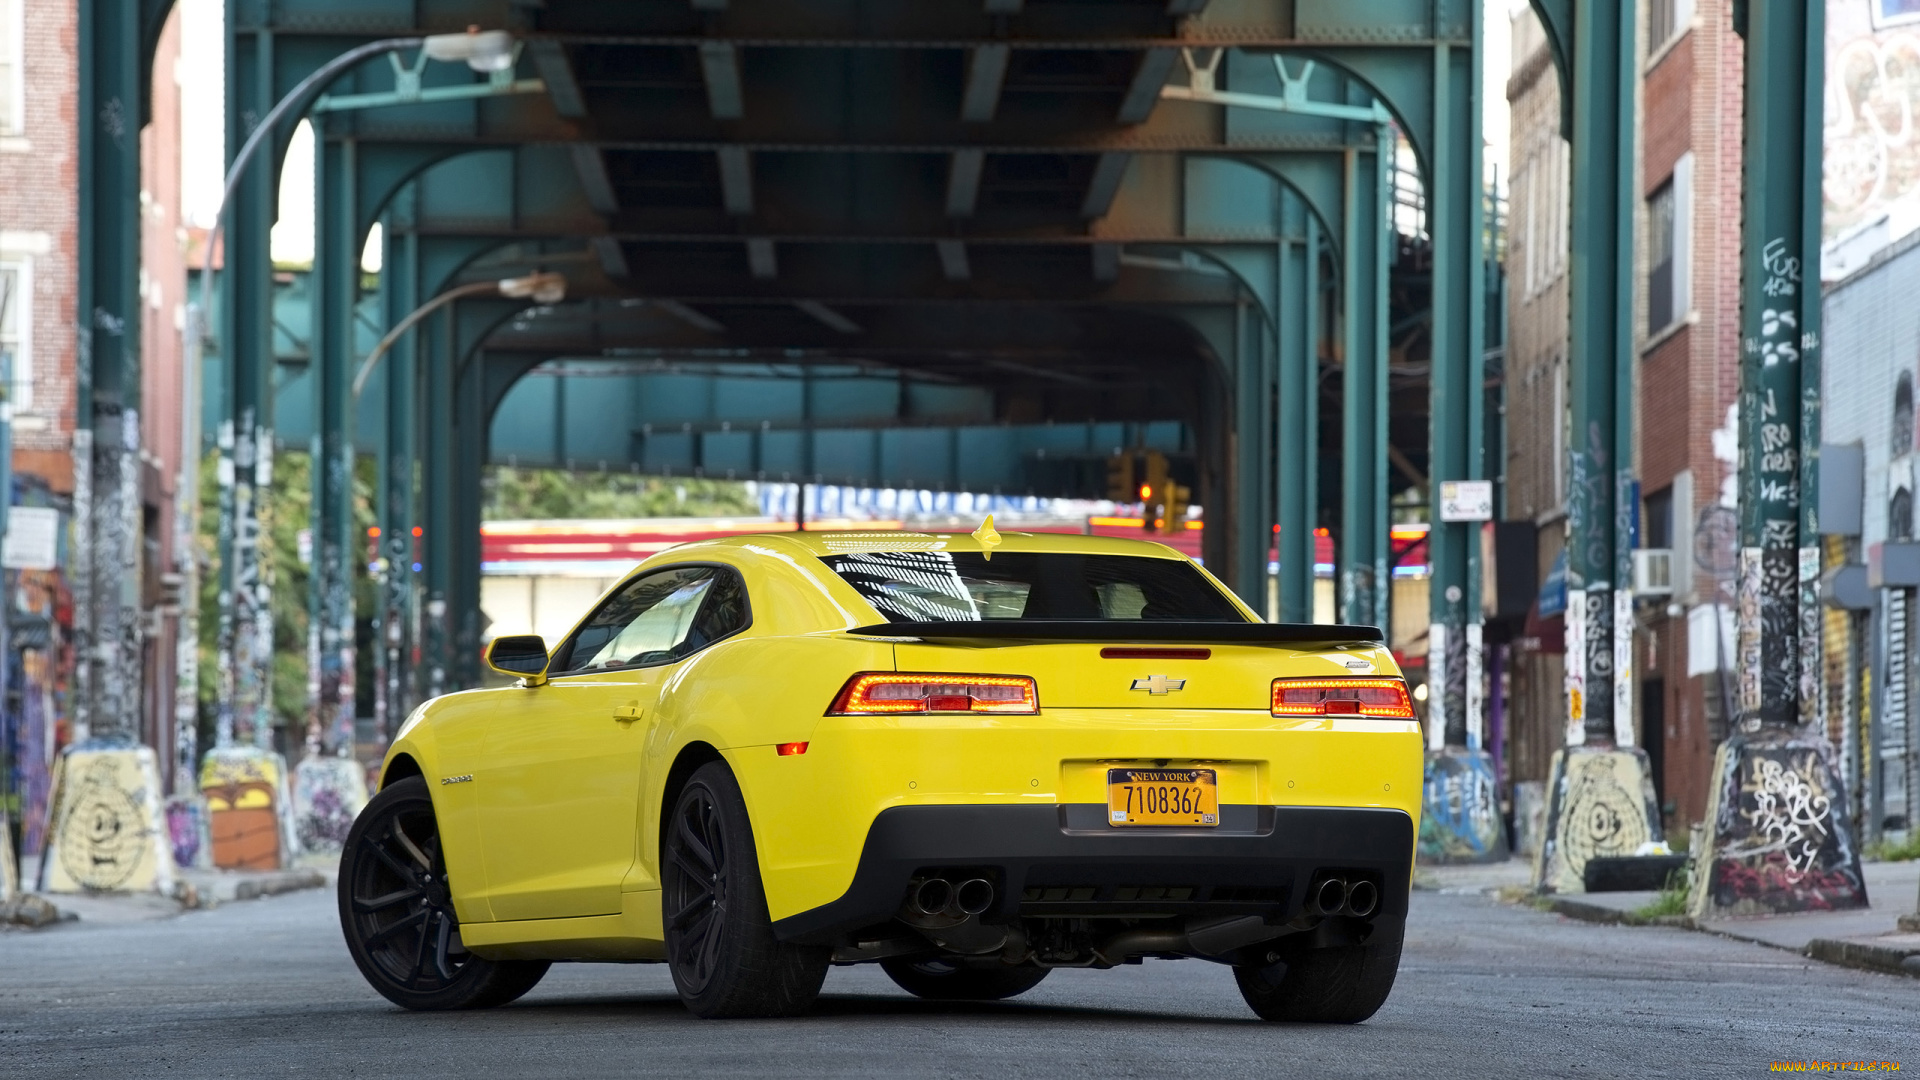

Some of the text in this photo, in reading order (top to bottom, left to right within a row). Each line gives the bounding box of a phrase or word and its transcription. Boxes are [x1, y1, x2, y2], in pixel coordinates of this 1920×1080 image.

[1134, 772, 1191, 782] NEW YORK
[1123, 786, 1204, 814] 7108362
